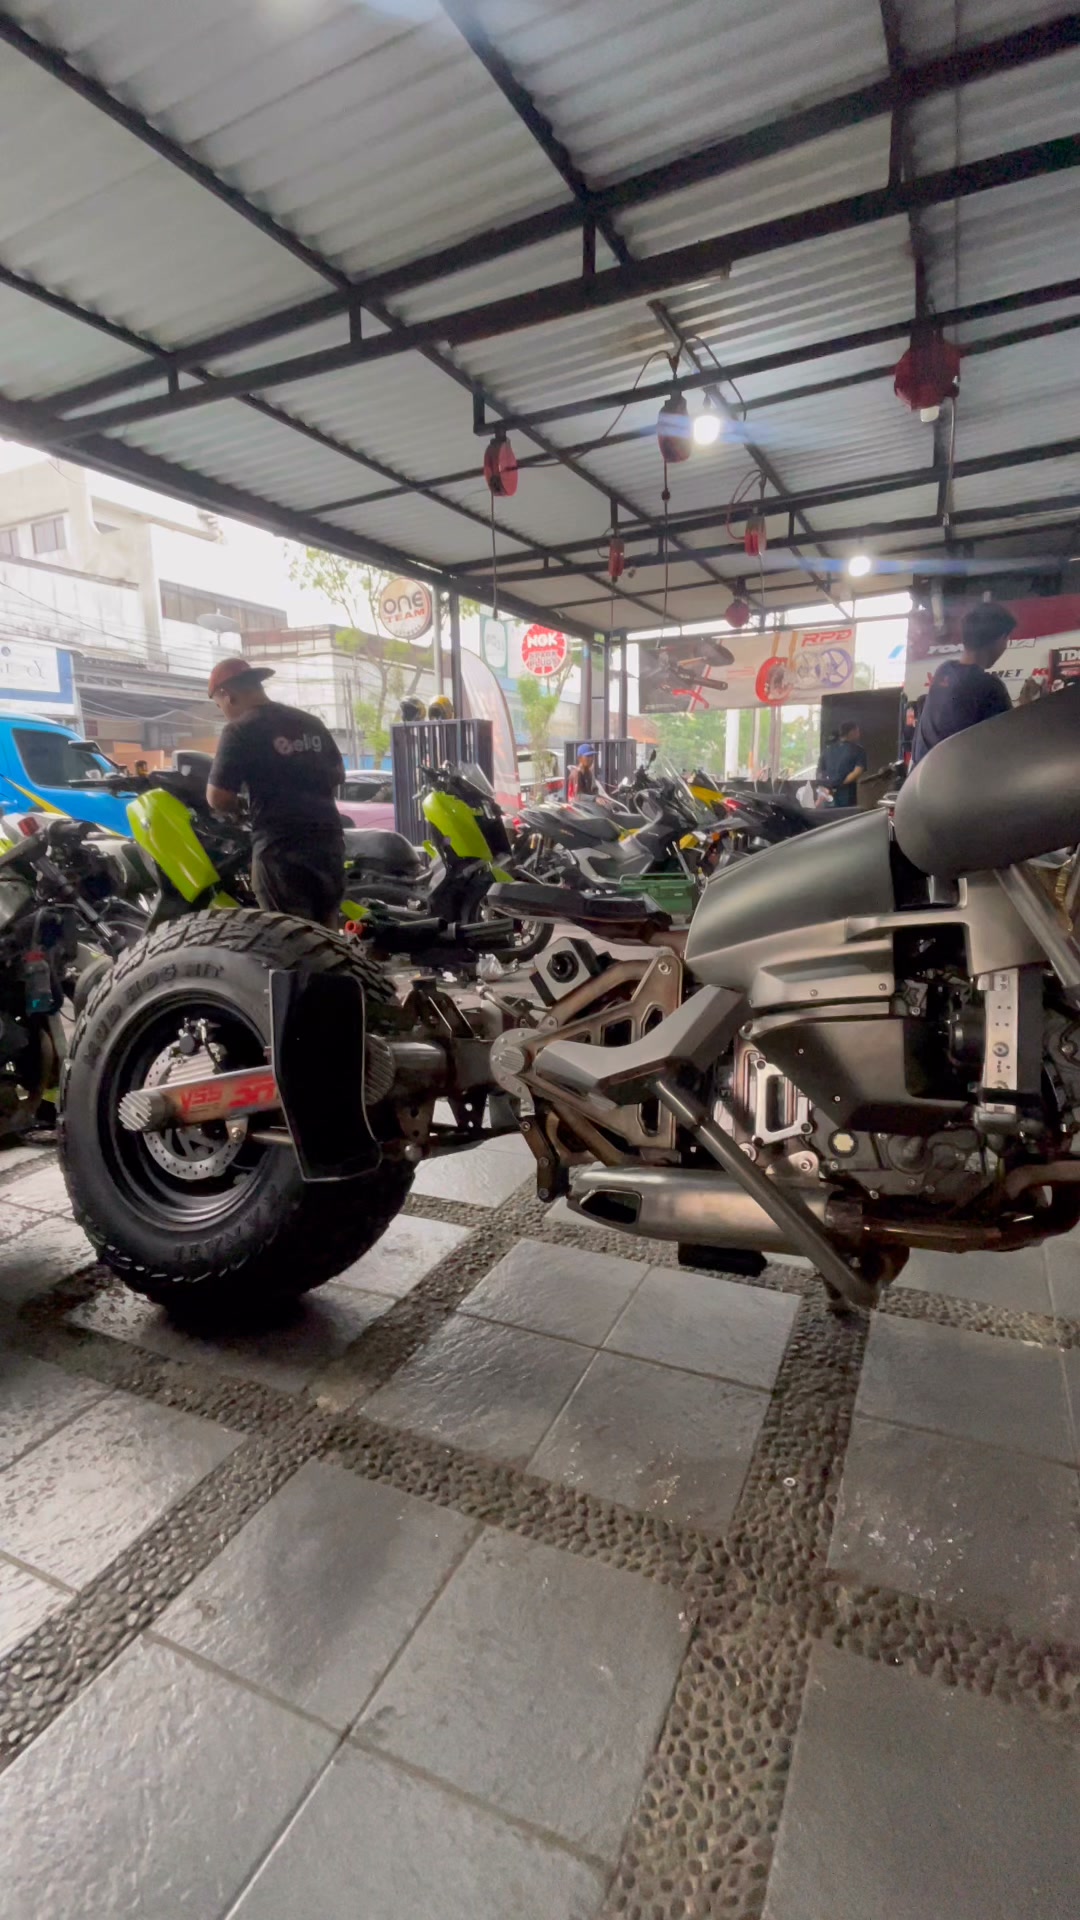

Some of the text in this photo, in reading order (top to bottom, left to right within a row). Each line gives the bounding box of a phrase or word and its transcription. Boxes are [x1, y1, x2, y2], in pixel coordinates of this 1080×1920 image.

[384, 608, 425, 623] TEAM
[527, 633, 558, 648] NGK
[801, 629, 853, 647] RPD
[1058, 649, 1080, 662] TD
